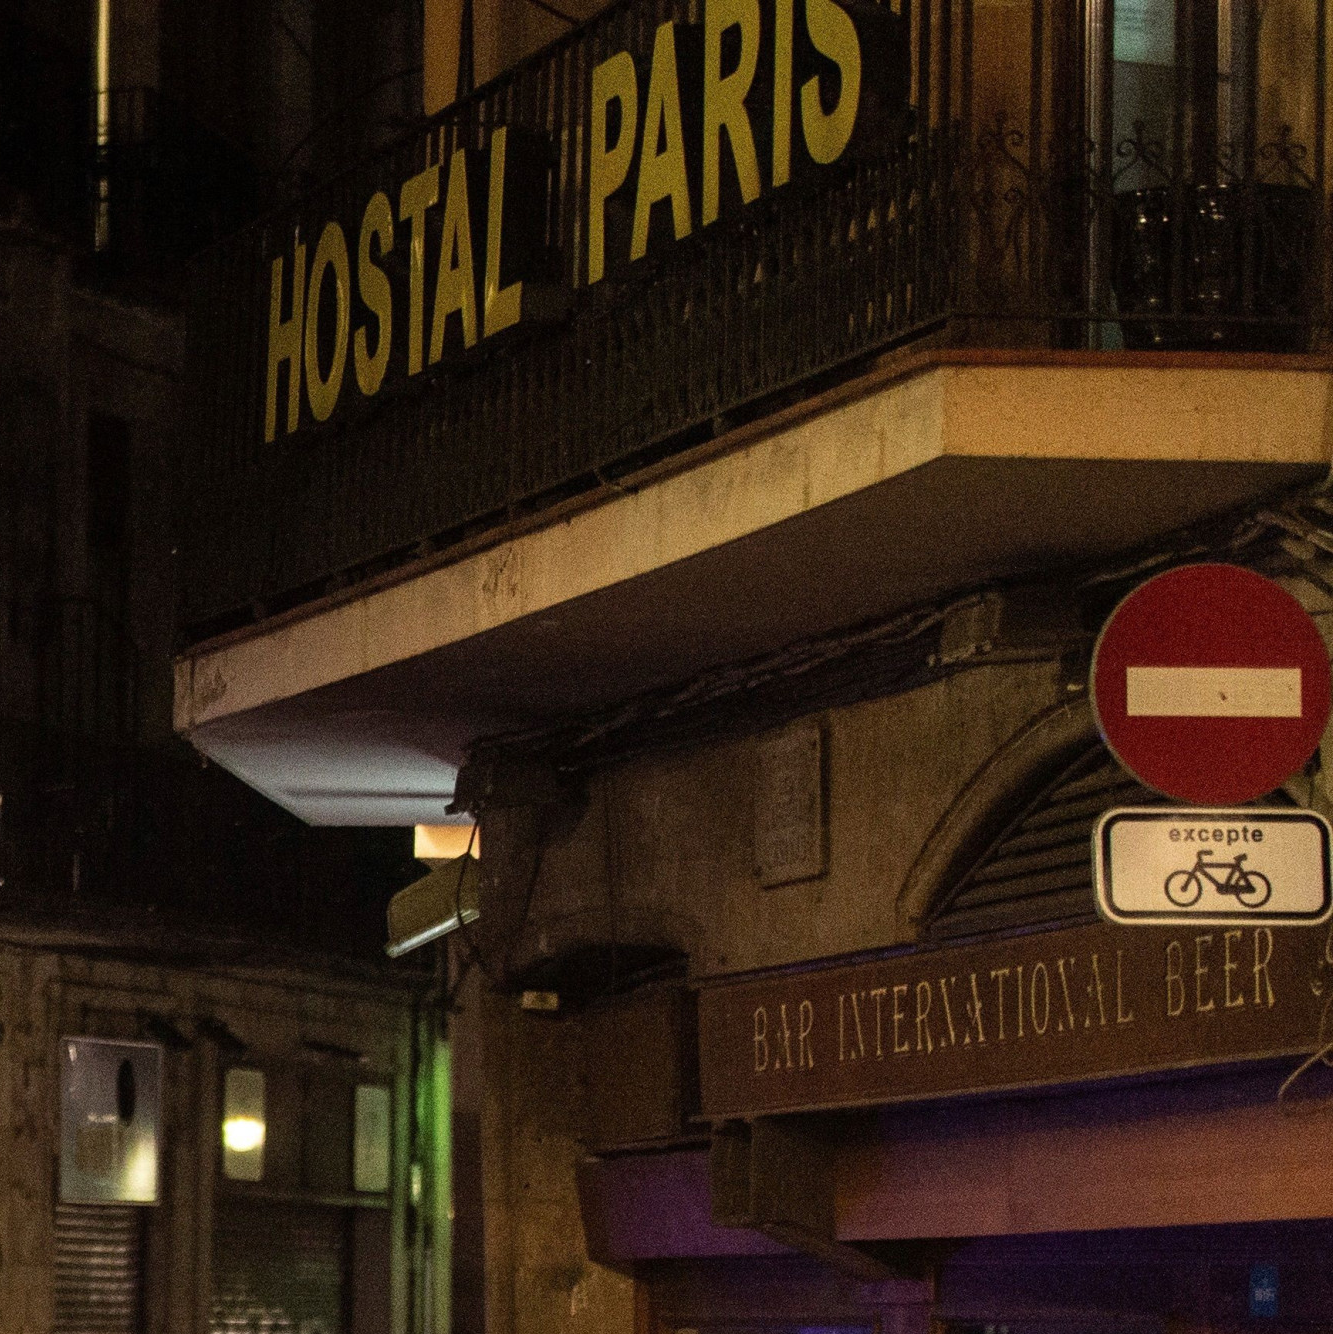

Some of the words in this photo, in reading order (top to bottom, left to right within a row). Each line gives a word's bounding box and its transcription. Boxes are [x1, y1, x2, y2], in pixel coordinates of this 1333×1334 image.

[264, 127, 523, 443] HOSTAL
[588, 0, 861, 285] PARIS
[1169, 826, 1263, 846] excepte
[753, 998, 815, 1074] BAR
[838, 949, 1133, 1062] INTERNATIONAL
[1165, 927, 1276, 1016] BEER
